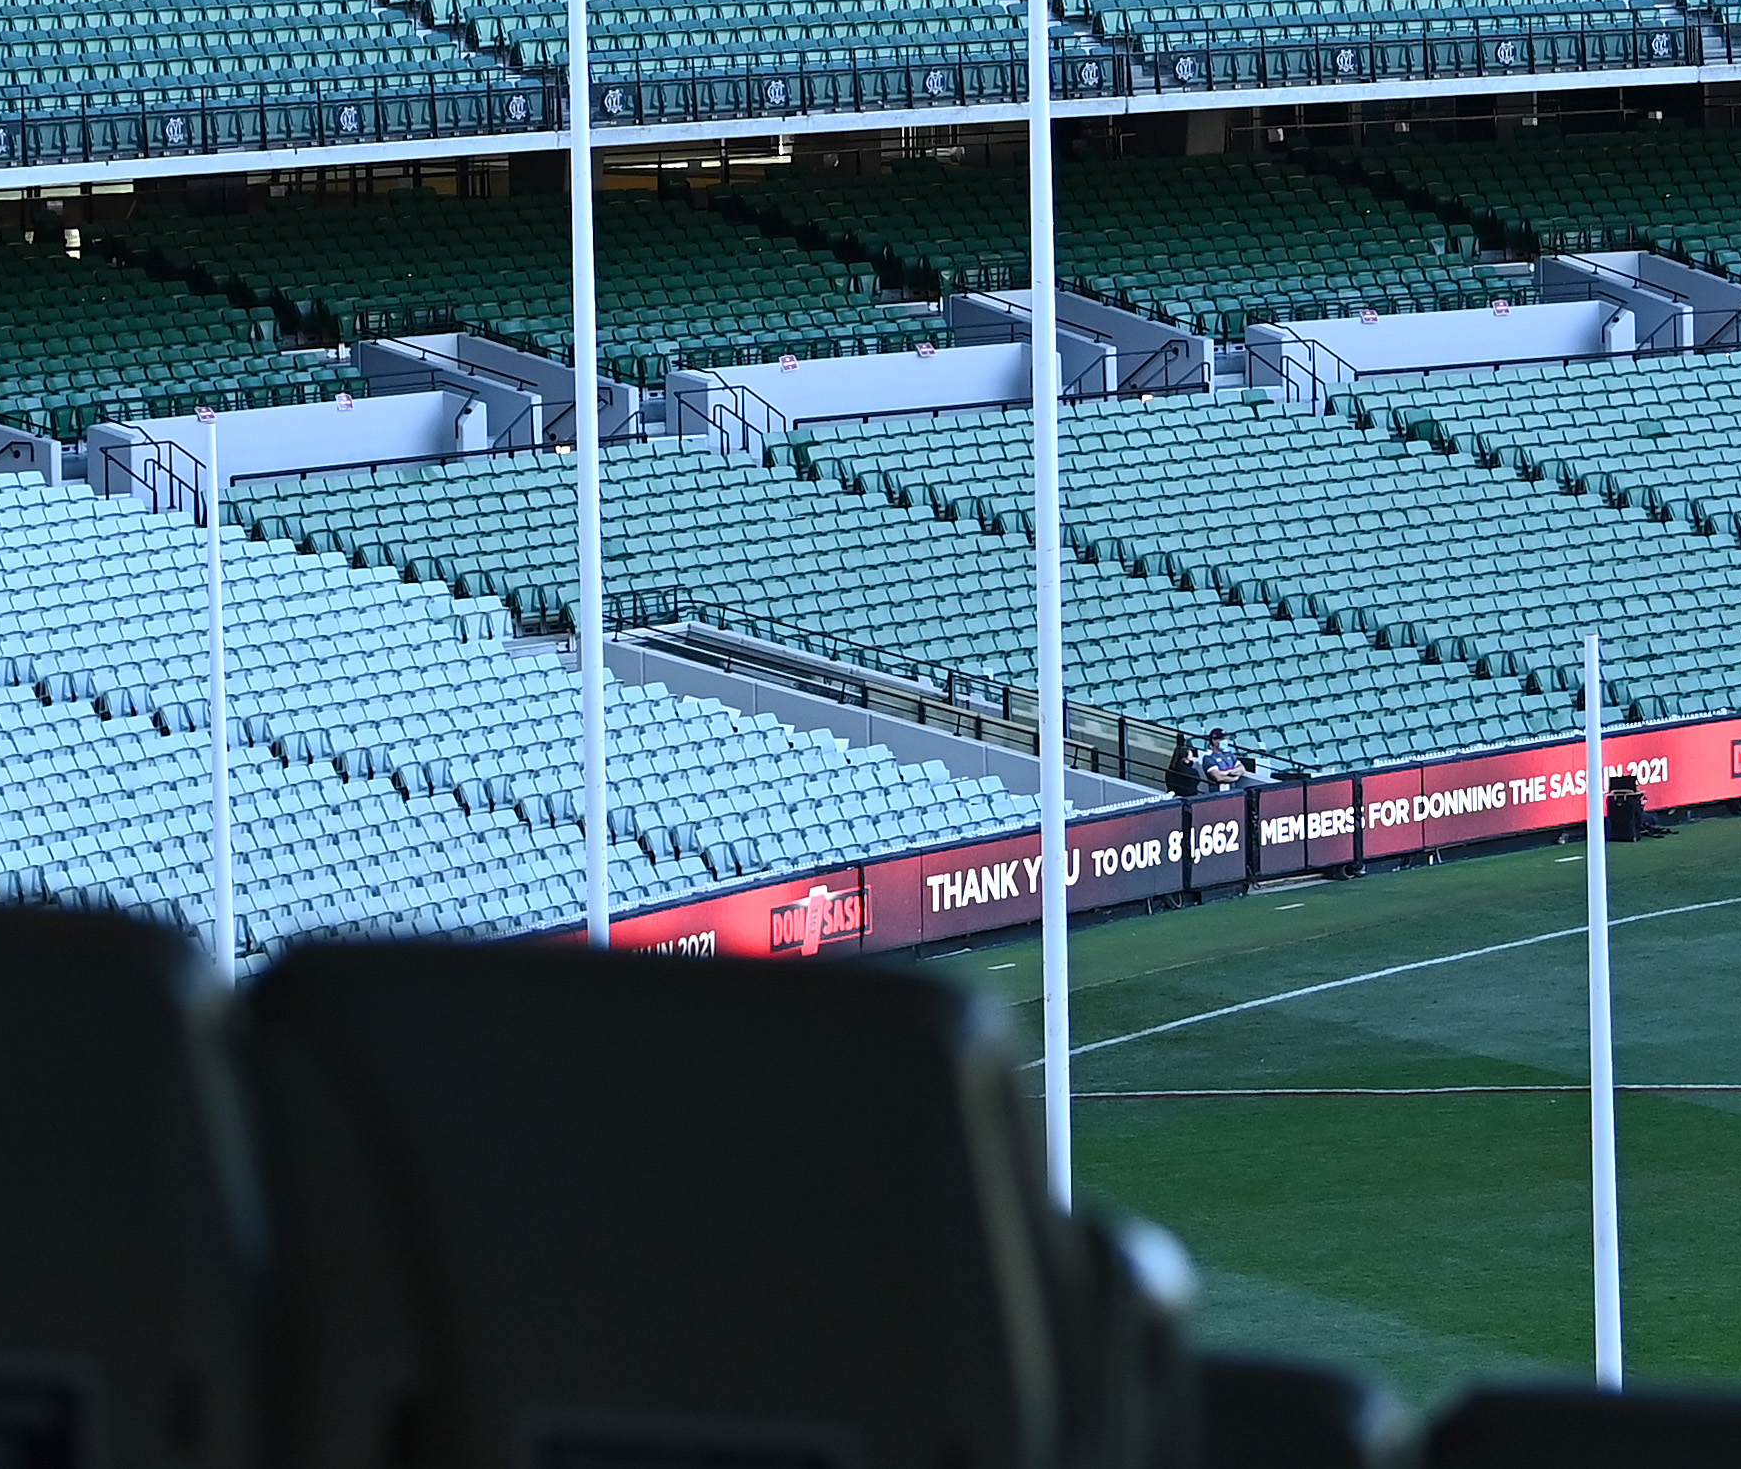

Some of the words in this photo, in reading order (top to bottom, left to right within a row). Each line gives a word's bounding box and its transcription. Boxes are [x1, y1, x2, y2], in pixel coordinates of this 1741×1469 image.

[926, 859, 1020, 913] THANK
[1022, 848, 1081, 894] YU
[1091, 846, 1119, 878] TO
[1121, 838, 1162, 871] OUR
[1168, 820, 1240, 864] 81,662
[1260, 807, 1366, 847] MEMBERS
[1368, 798, 1410, 829] FOR
[1413, 788, 1506, 822] DONNING
[1509, 777, 1547, 806] THE
[1550, 768, 1588, 799] SAS
[1626, 756, 1669, 785] 2021
[772, 908, 807, 947] DON
[823, 894, 869, 935] SASH
